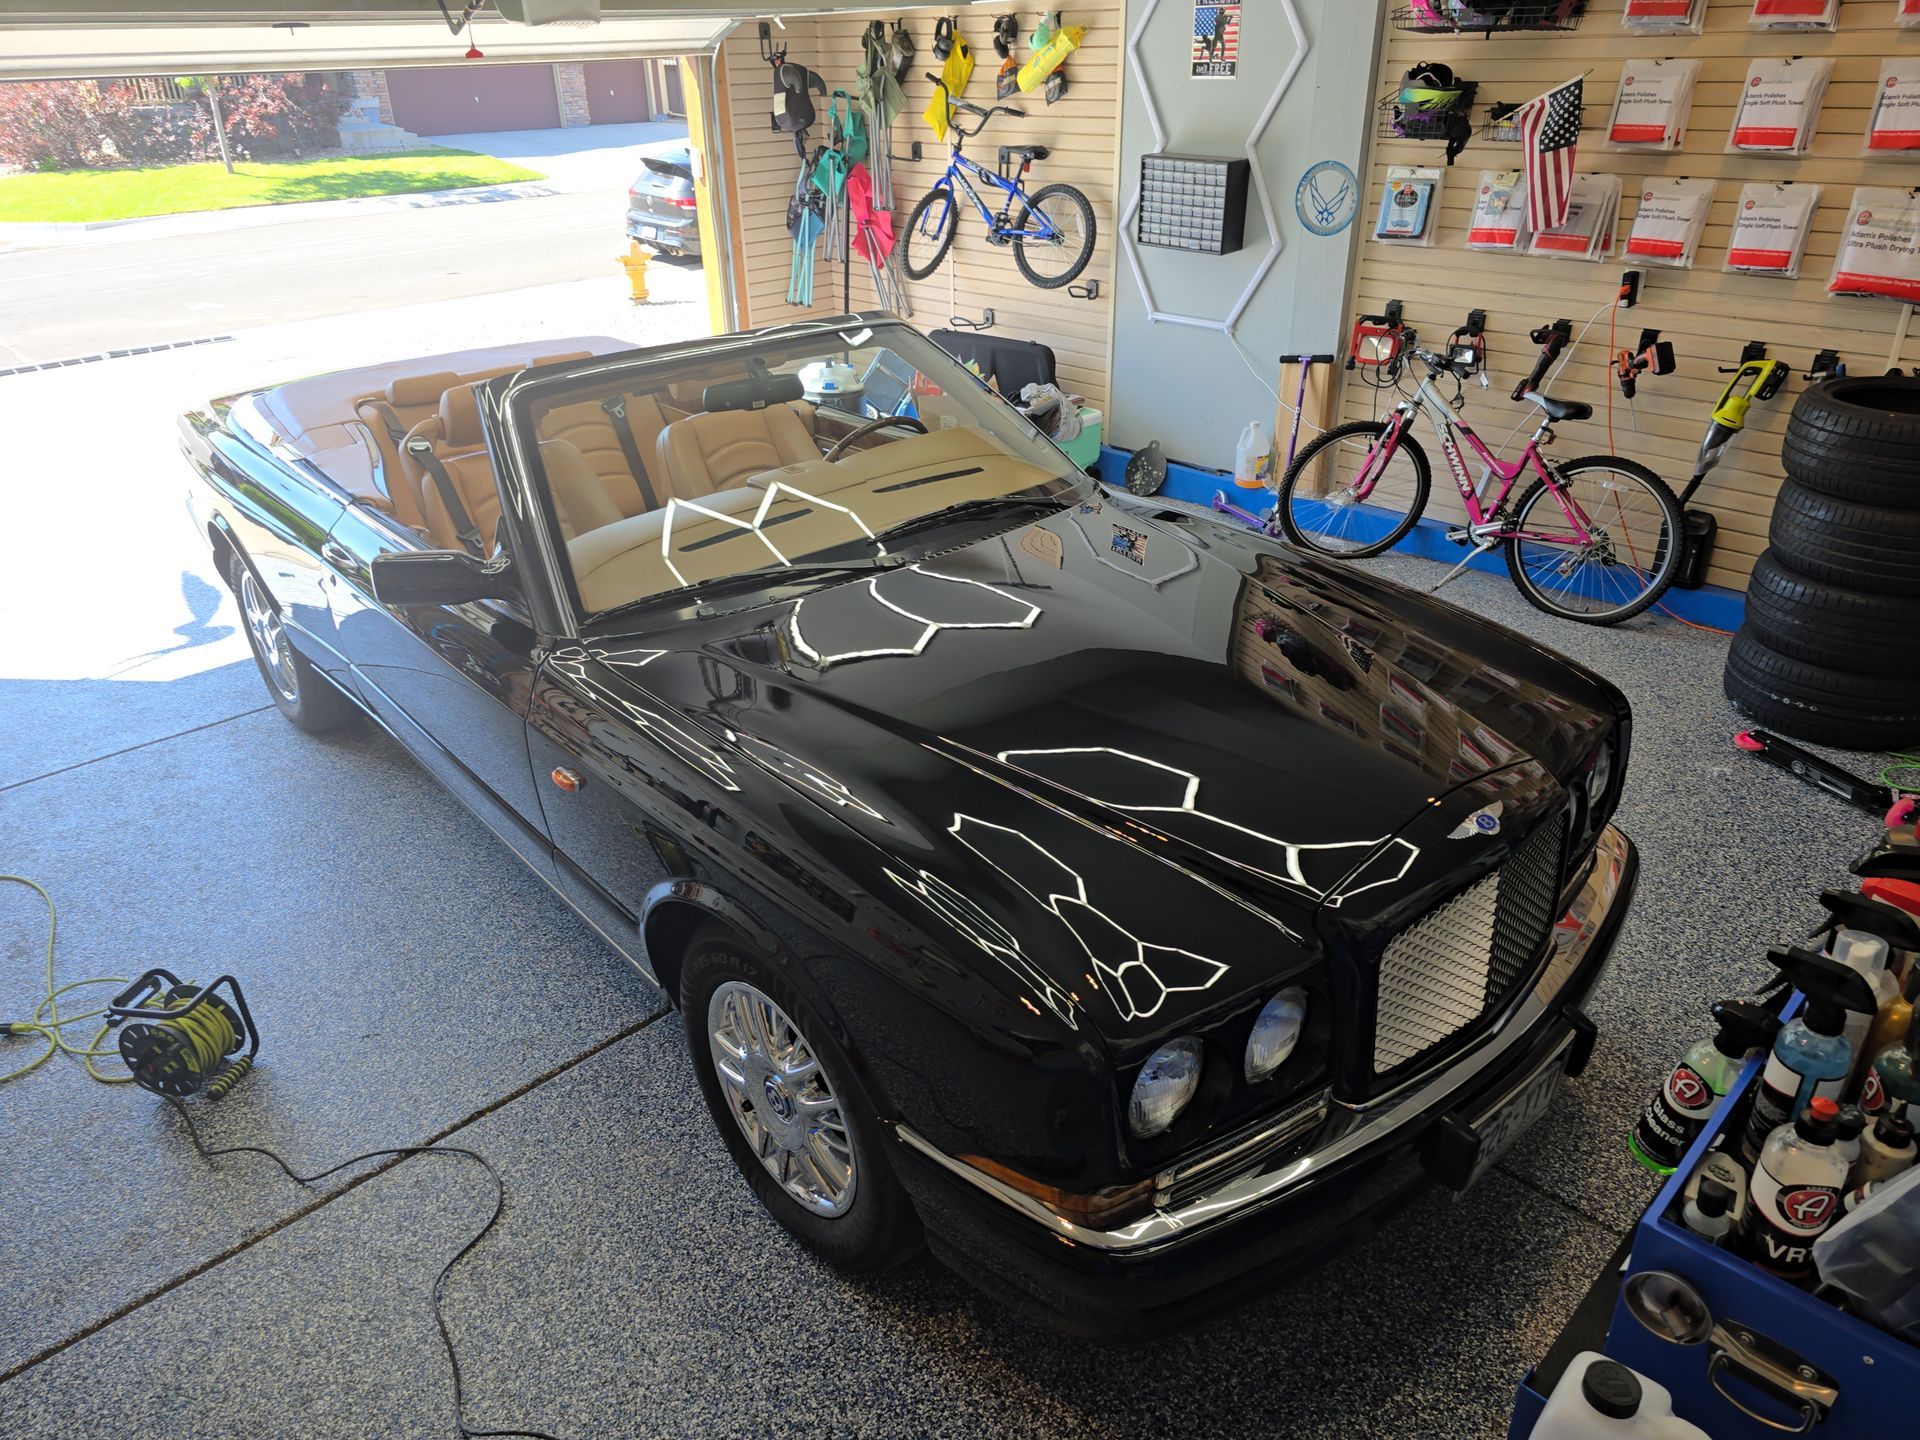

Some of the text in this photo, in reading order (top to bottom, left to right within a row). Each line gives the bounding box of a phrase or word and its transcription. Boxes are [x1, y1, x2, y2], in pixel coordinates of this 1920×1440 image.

[1209, 62, 1231, 75] FREE
[1847, 240, 1864, 248] Ultra
[1865, 241, 1888, 251] Plush
[1889, 244, 1915, 254] Drying
[1851, 231, 1912, 243] Adam's Polishes
[1438, 424, 1472, 491] SCHWINN
[1646, 1106, 1686, 1146] Cleaner
[1653, 1097, 1685, 1134] Glass
